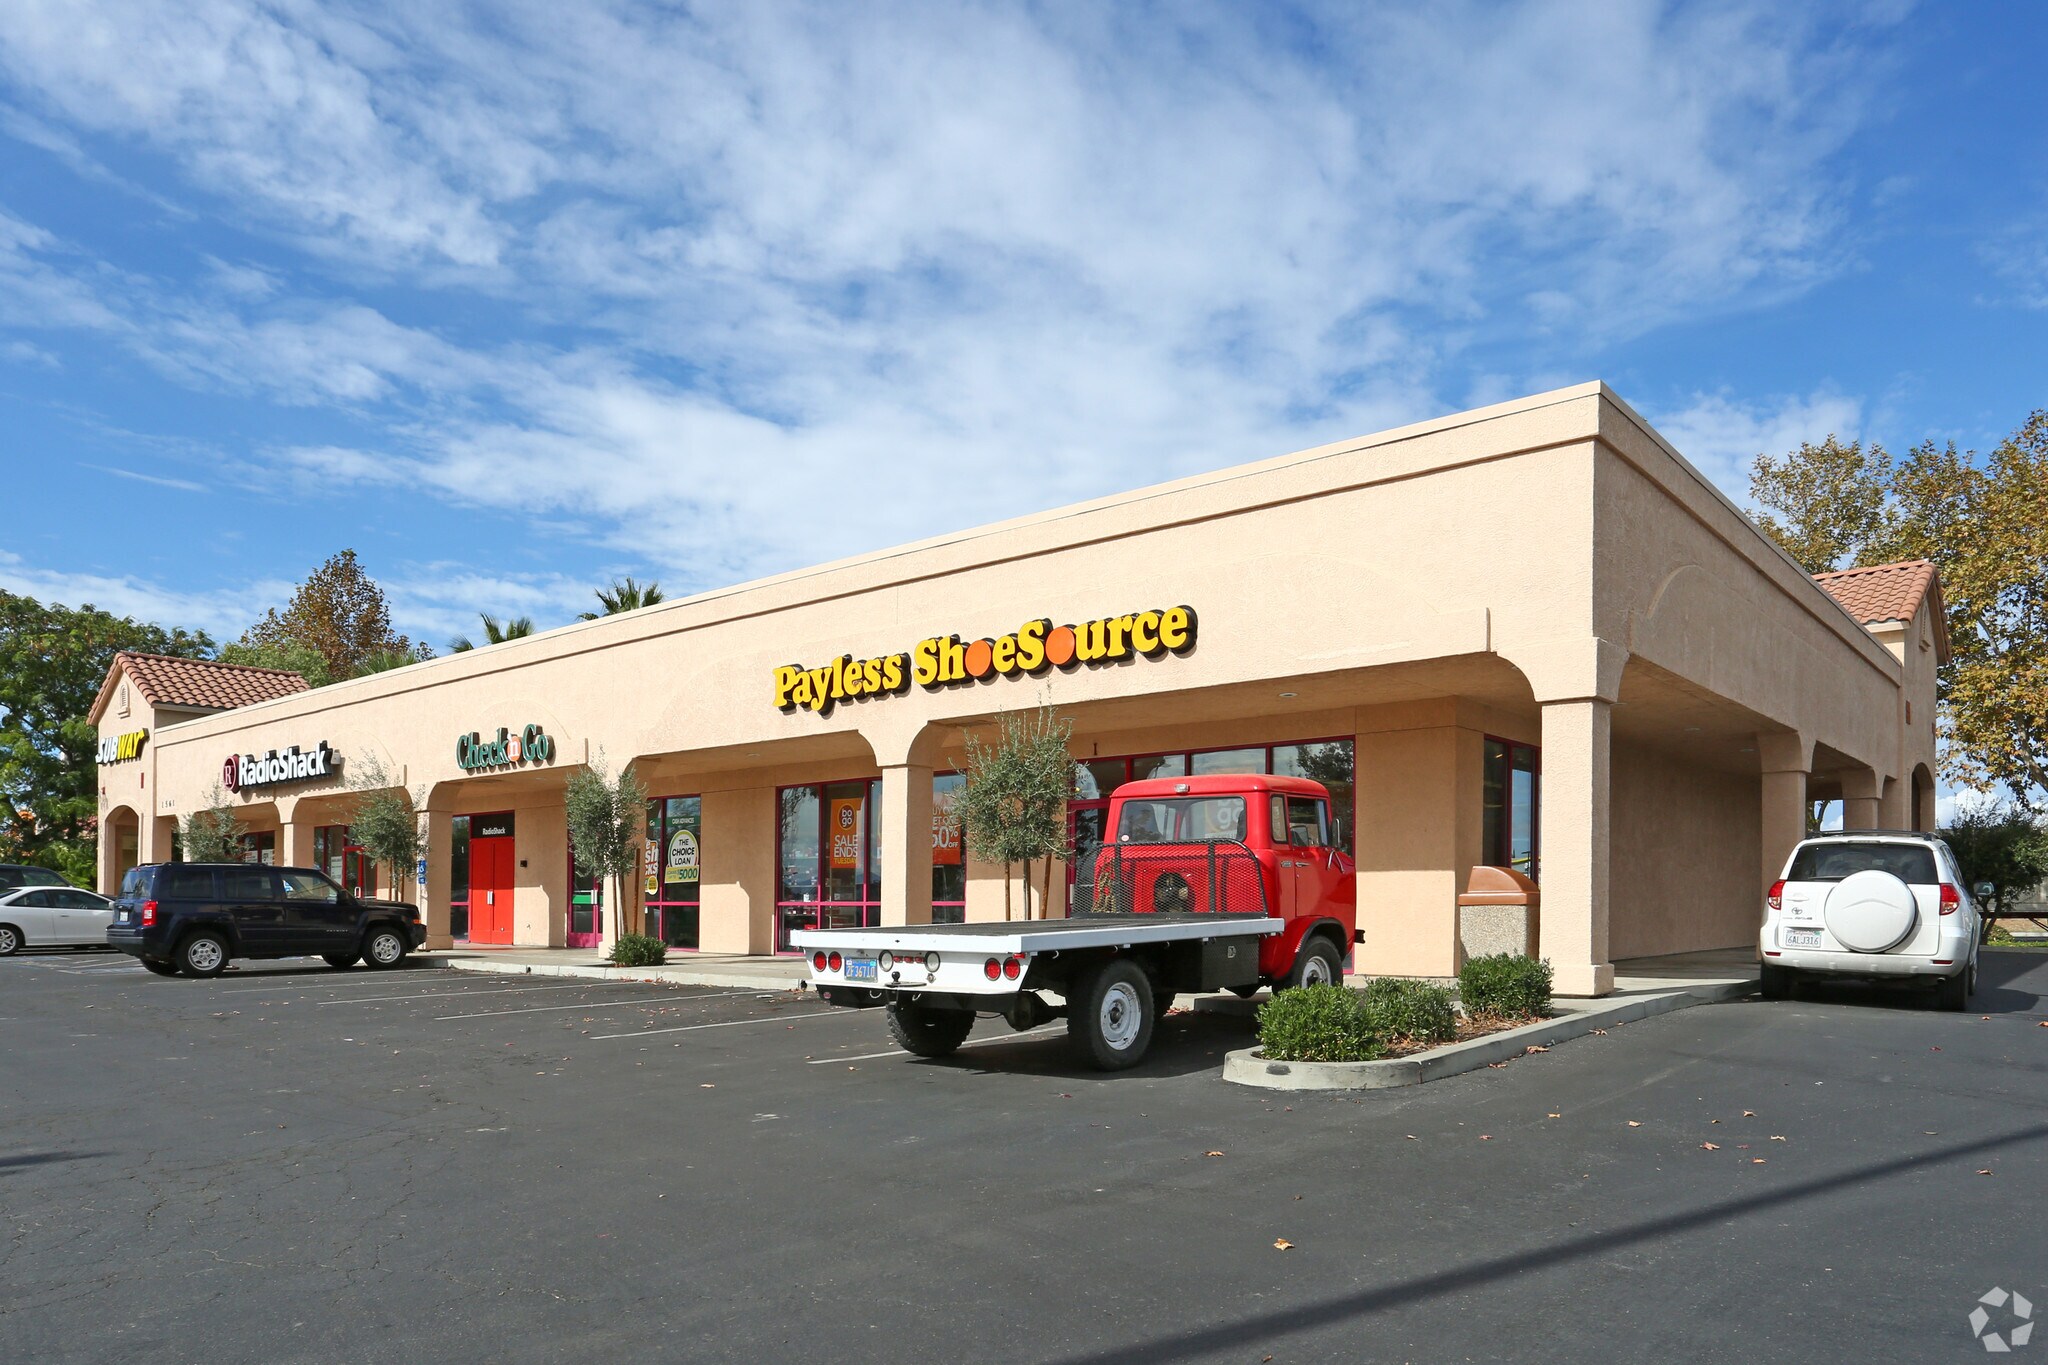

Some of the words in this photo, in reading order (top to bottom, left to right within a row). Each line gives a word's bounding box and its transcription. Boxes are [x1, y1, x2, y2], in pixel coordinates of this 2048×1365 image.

[772, 653, 903, 711] Payless
[913, 606, 1190, 686] ShoeSource
[95, 730, 145, 764] SUBWAY
[456, 727, 510, 769] Check
[522, 723, 549, 761] Go
[238, 742, 326, 786] RadioShack
[932, 806, 942, 816] UY
[932, 816, 942, 825] ET
[482, 827, 506, 835] RadioShack
[834, 834, 858, 847] SALE
[672, 847, 695, 857] CHOICE
[834, 846, 858, 858] ENDS
[675, 857, 691, 866] LOAN
